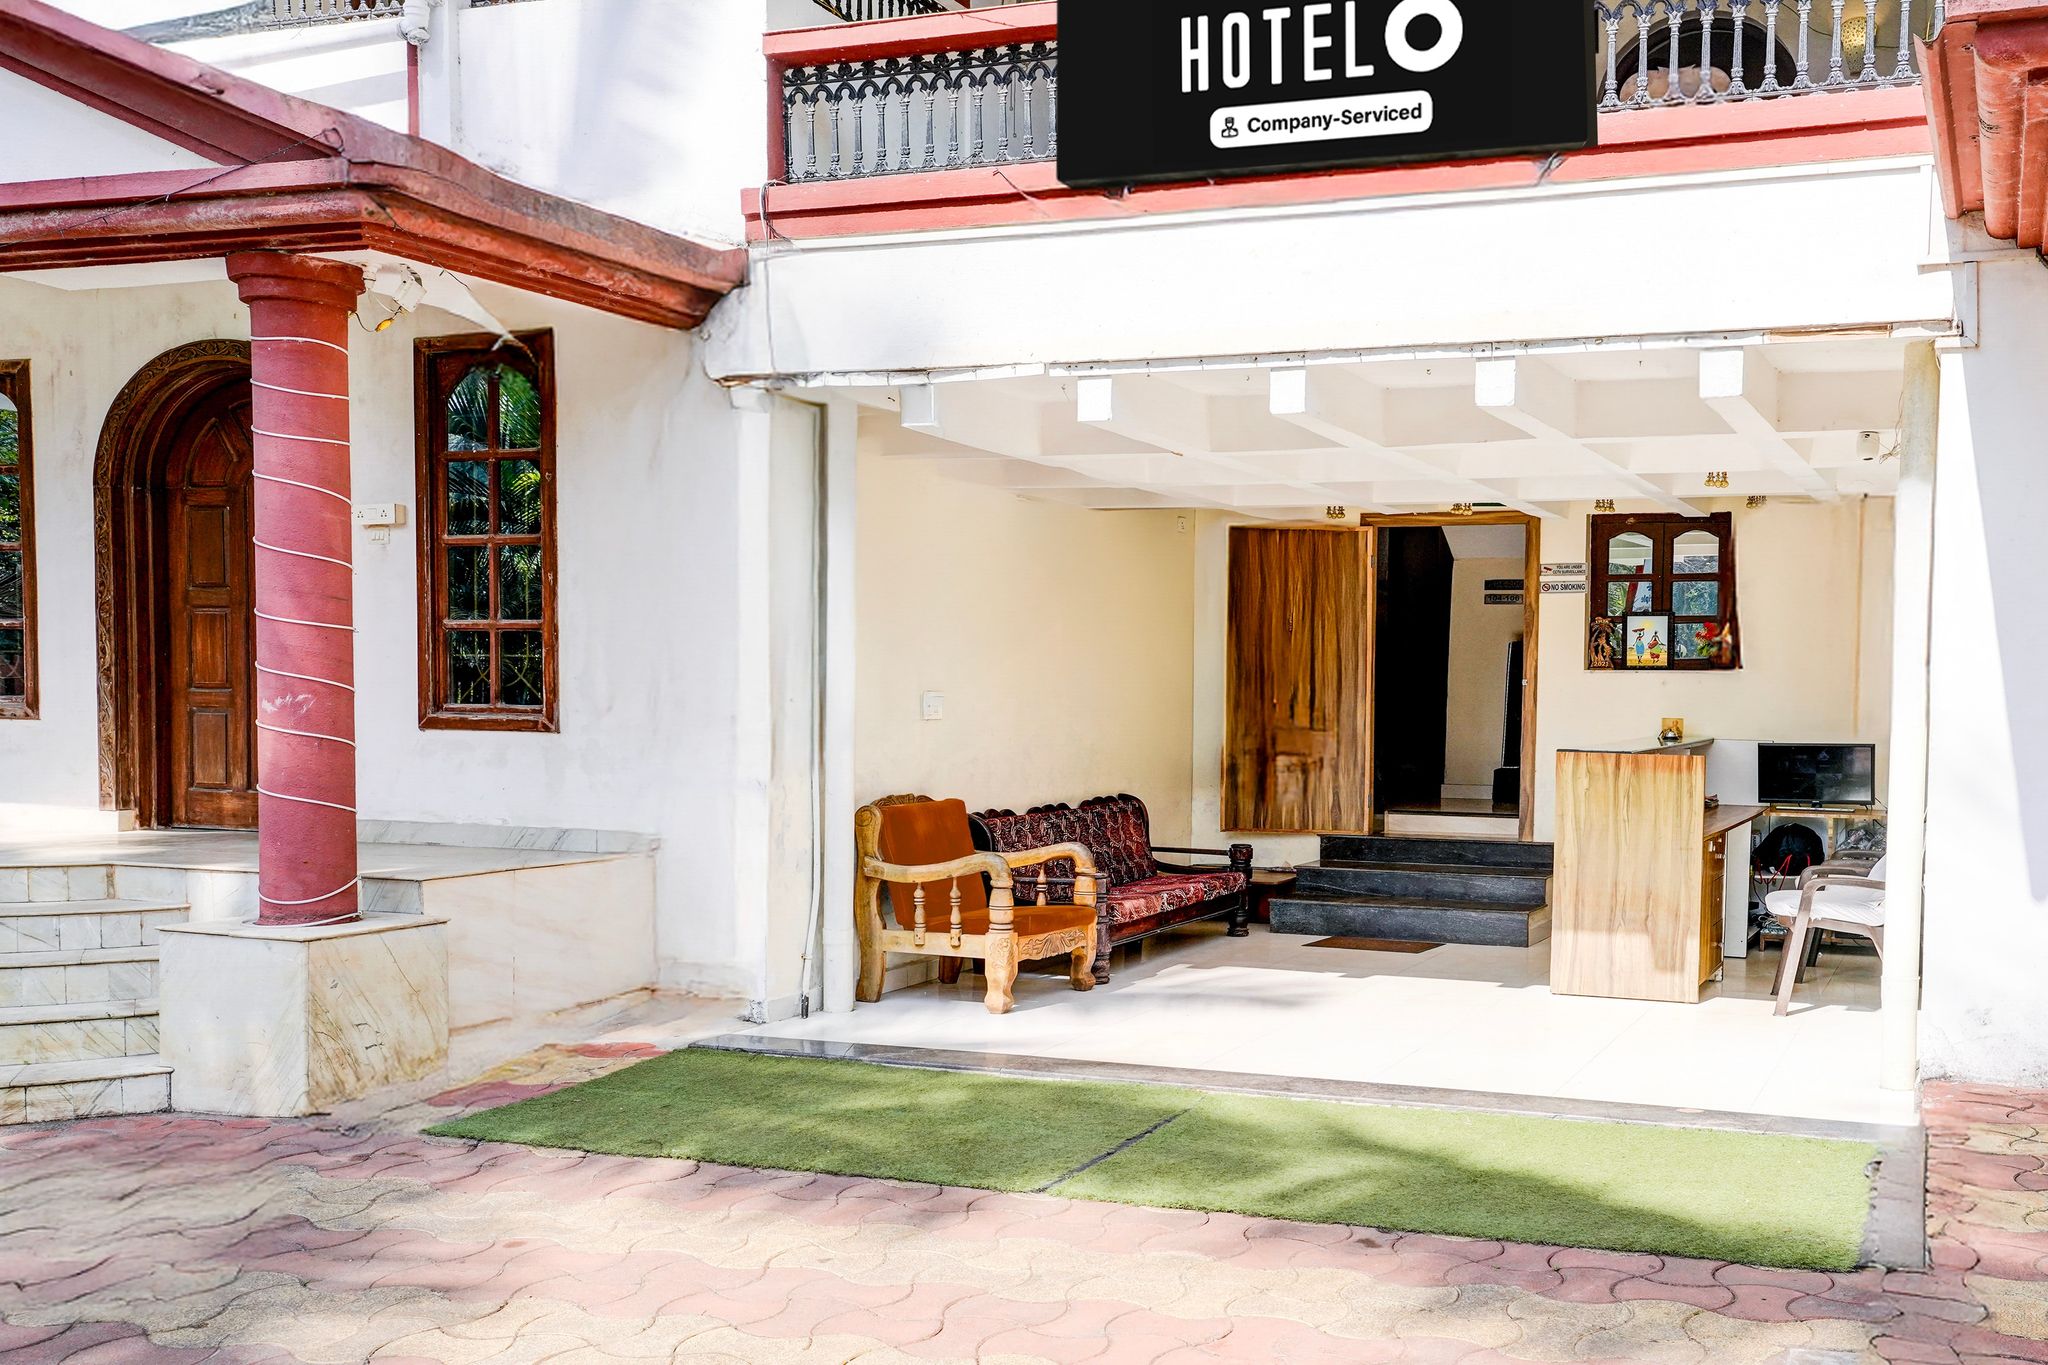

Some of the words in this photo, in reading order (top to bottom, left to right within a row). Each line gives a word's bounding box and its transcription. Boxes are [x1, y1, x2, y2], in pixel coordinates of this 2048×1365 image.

[1181, 1, 1374, 93] HOTEL
[1385, 0, 1463, 72] O
[1247, 102, 1422, 133] Company-Serviced
